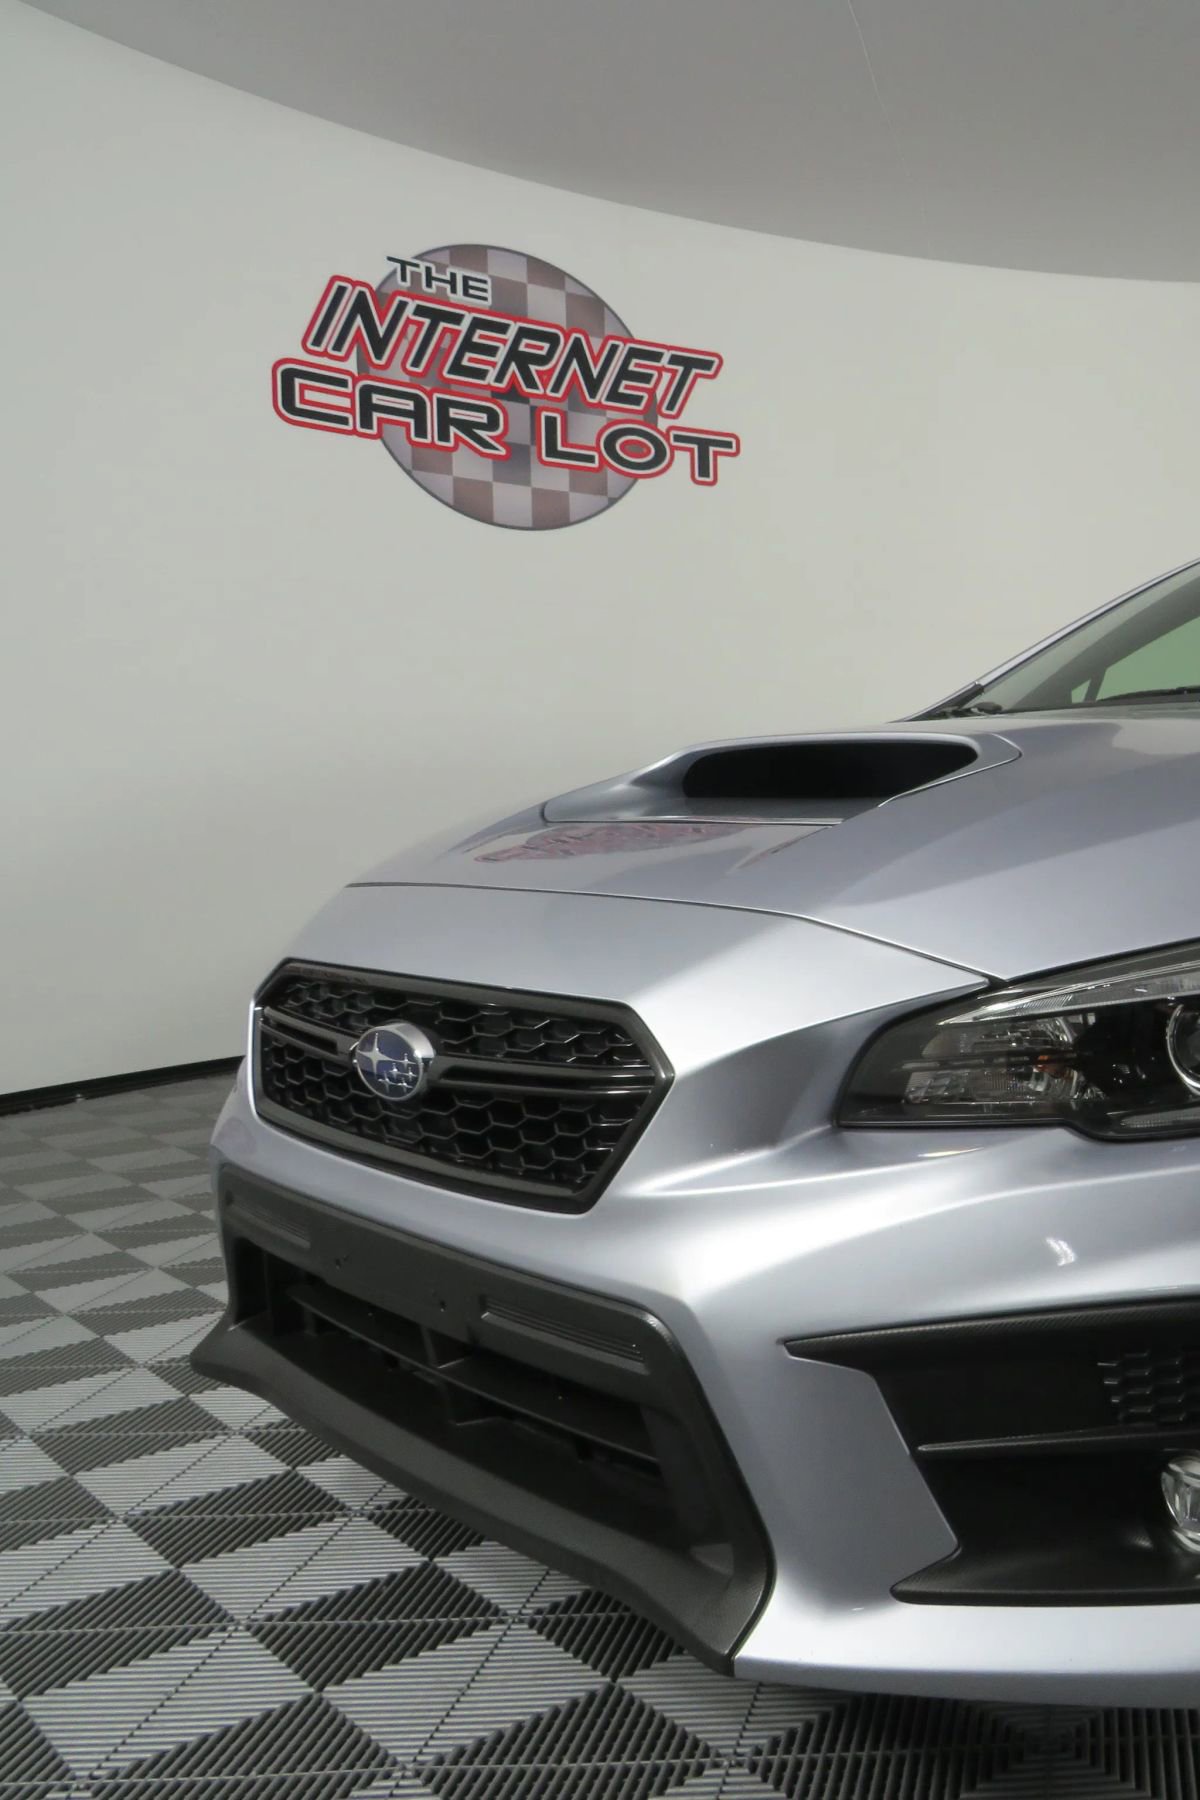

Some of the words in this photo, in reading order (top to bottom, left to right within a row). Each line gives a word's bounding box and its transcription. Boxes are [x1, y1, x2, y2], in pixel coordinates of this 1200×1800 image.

[387, 255, 491, 304] THE
[303, 276, 721, 417] INTERNET
[273, 359, 507, 460] CAR
[537, 407, 739, 485] LOT
